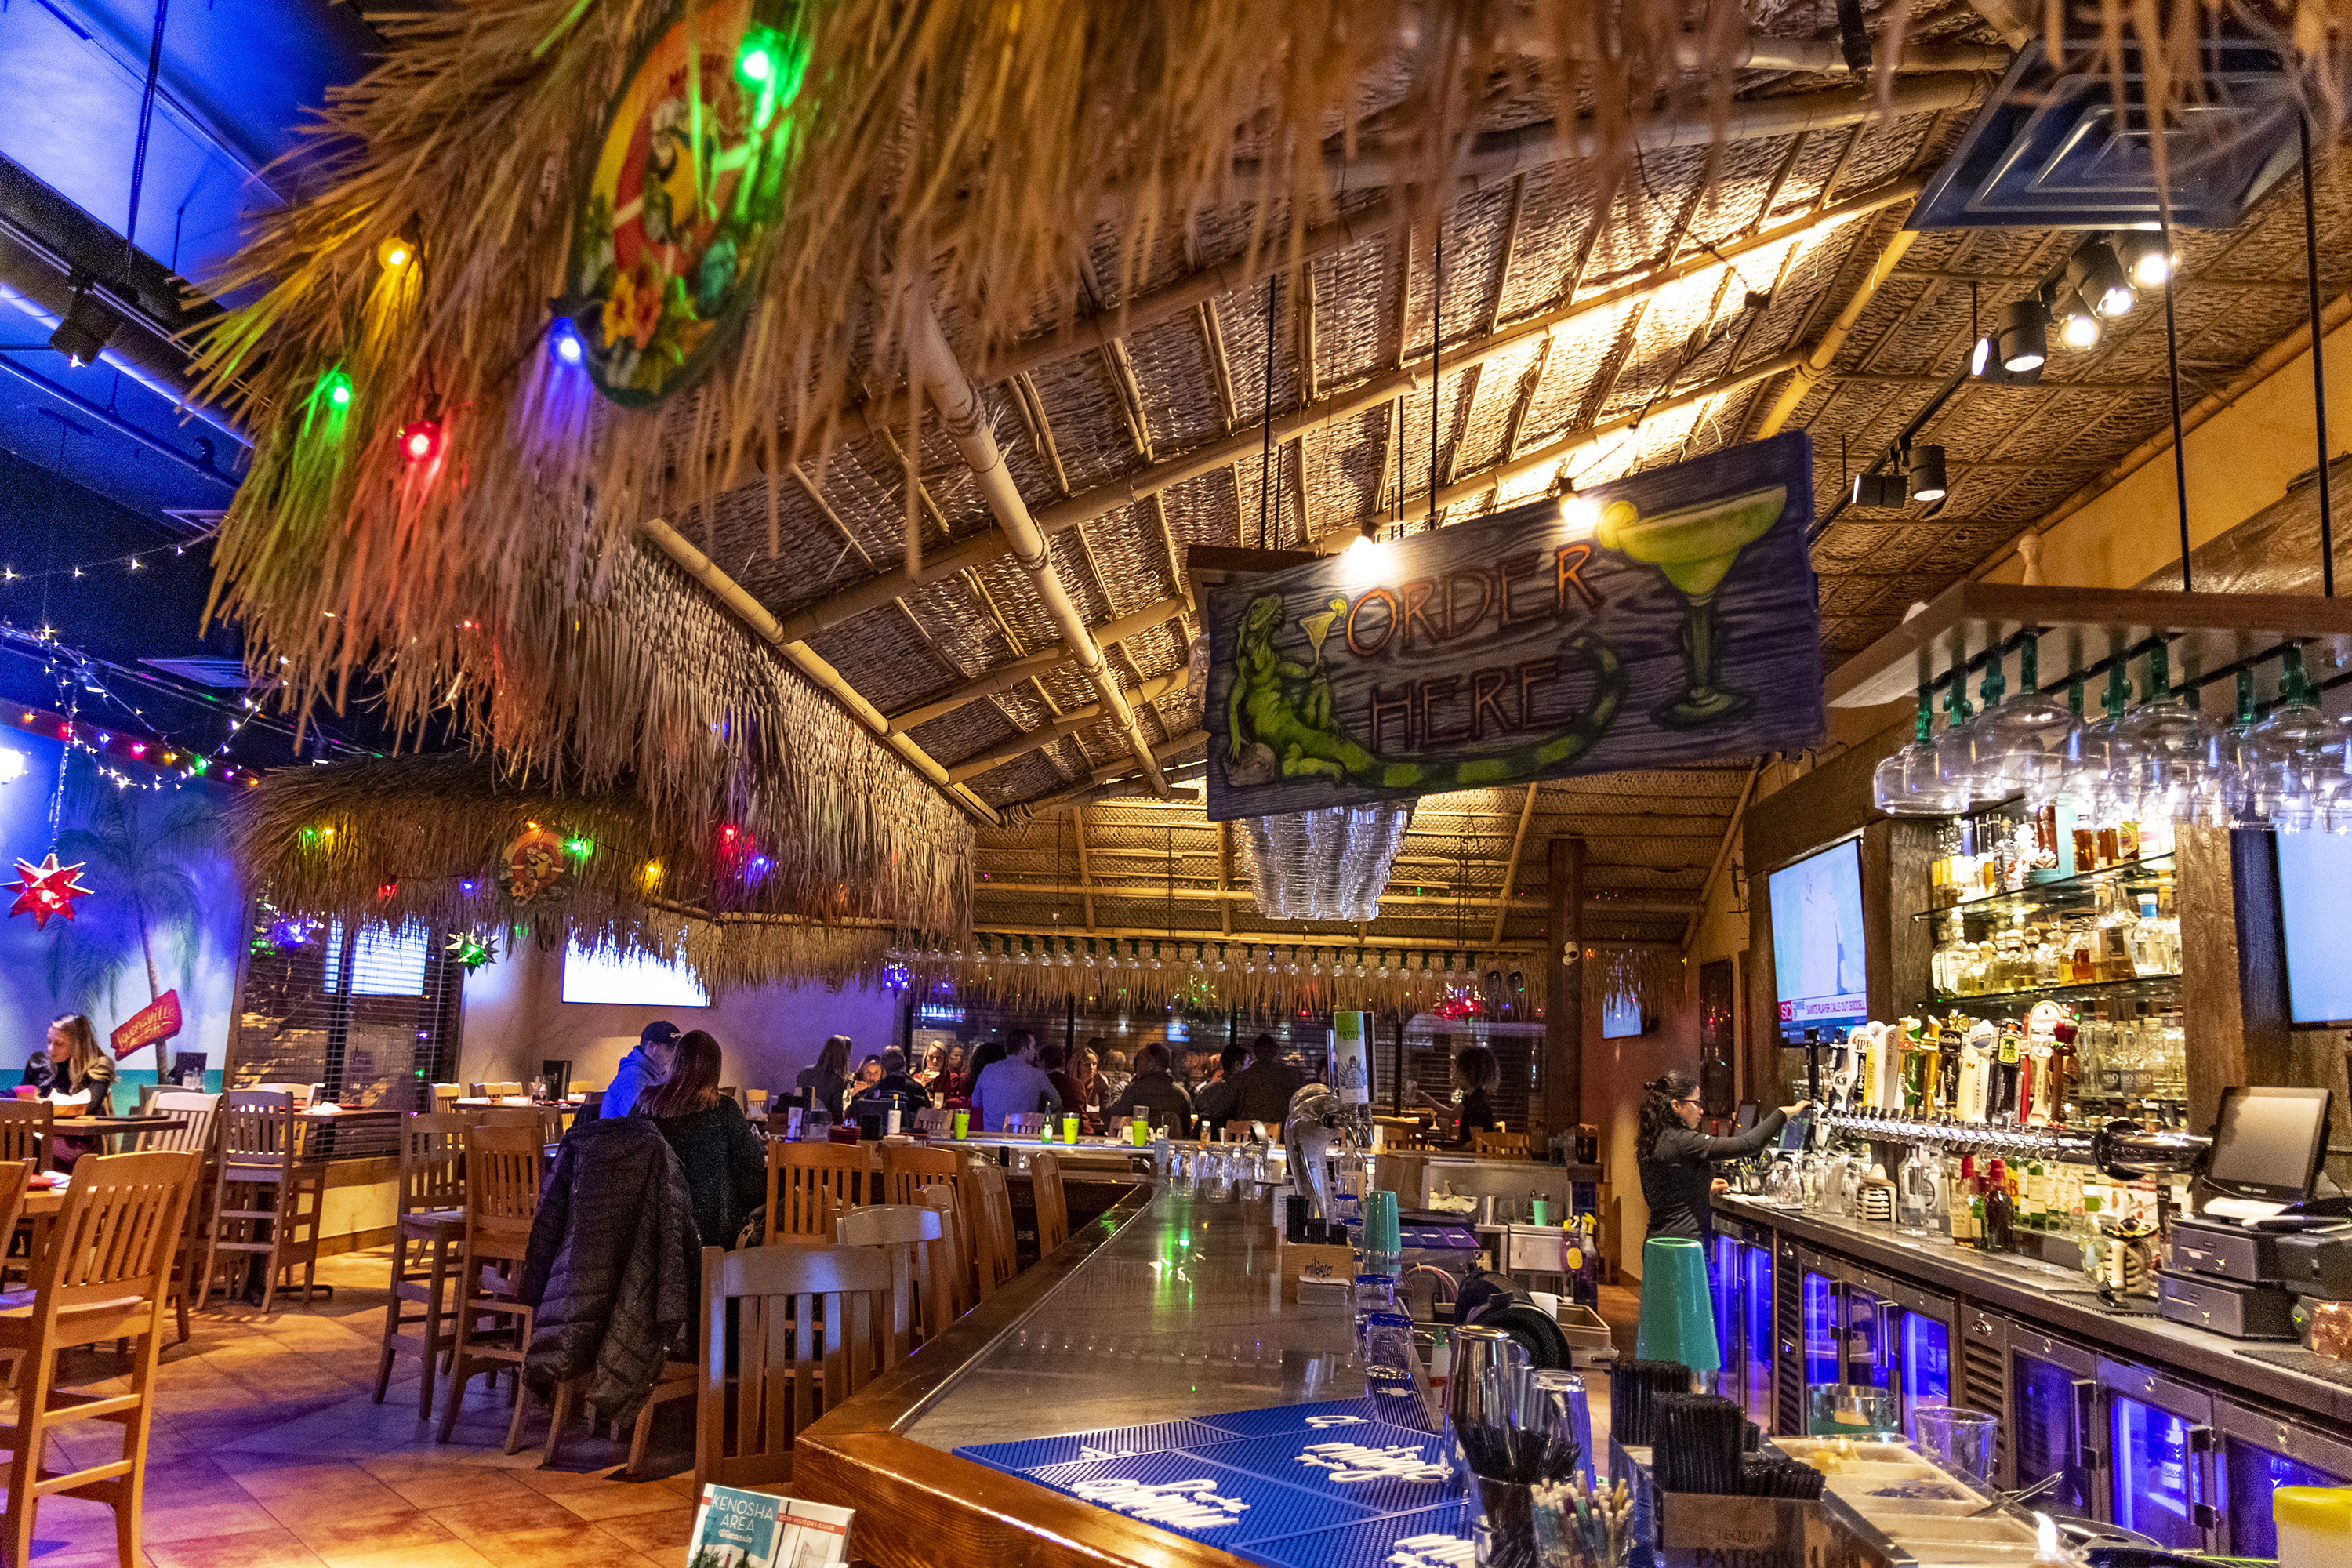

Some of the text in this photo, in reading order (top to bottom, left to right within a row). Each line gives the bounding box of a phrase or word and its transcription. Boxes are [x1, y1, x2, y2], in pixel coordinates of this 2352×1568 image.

[1347, 542, 1602, 657] ORDER
[1369, 657, 1577, 751] HERE
[1780, 1004, 1792, 1020] SC
[711, 1494, 774, 1522] KENOSHA
[720, 1513, 756, 1534] AREA
[778, 1514, 836, 1532] 2019 VISITORS GUIDE
[718, 1528, 753, 1544] Wisconsin
[1715, 1528, 1775, 1543] TEQUILA
